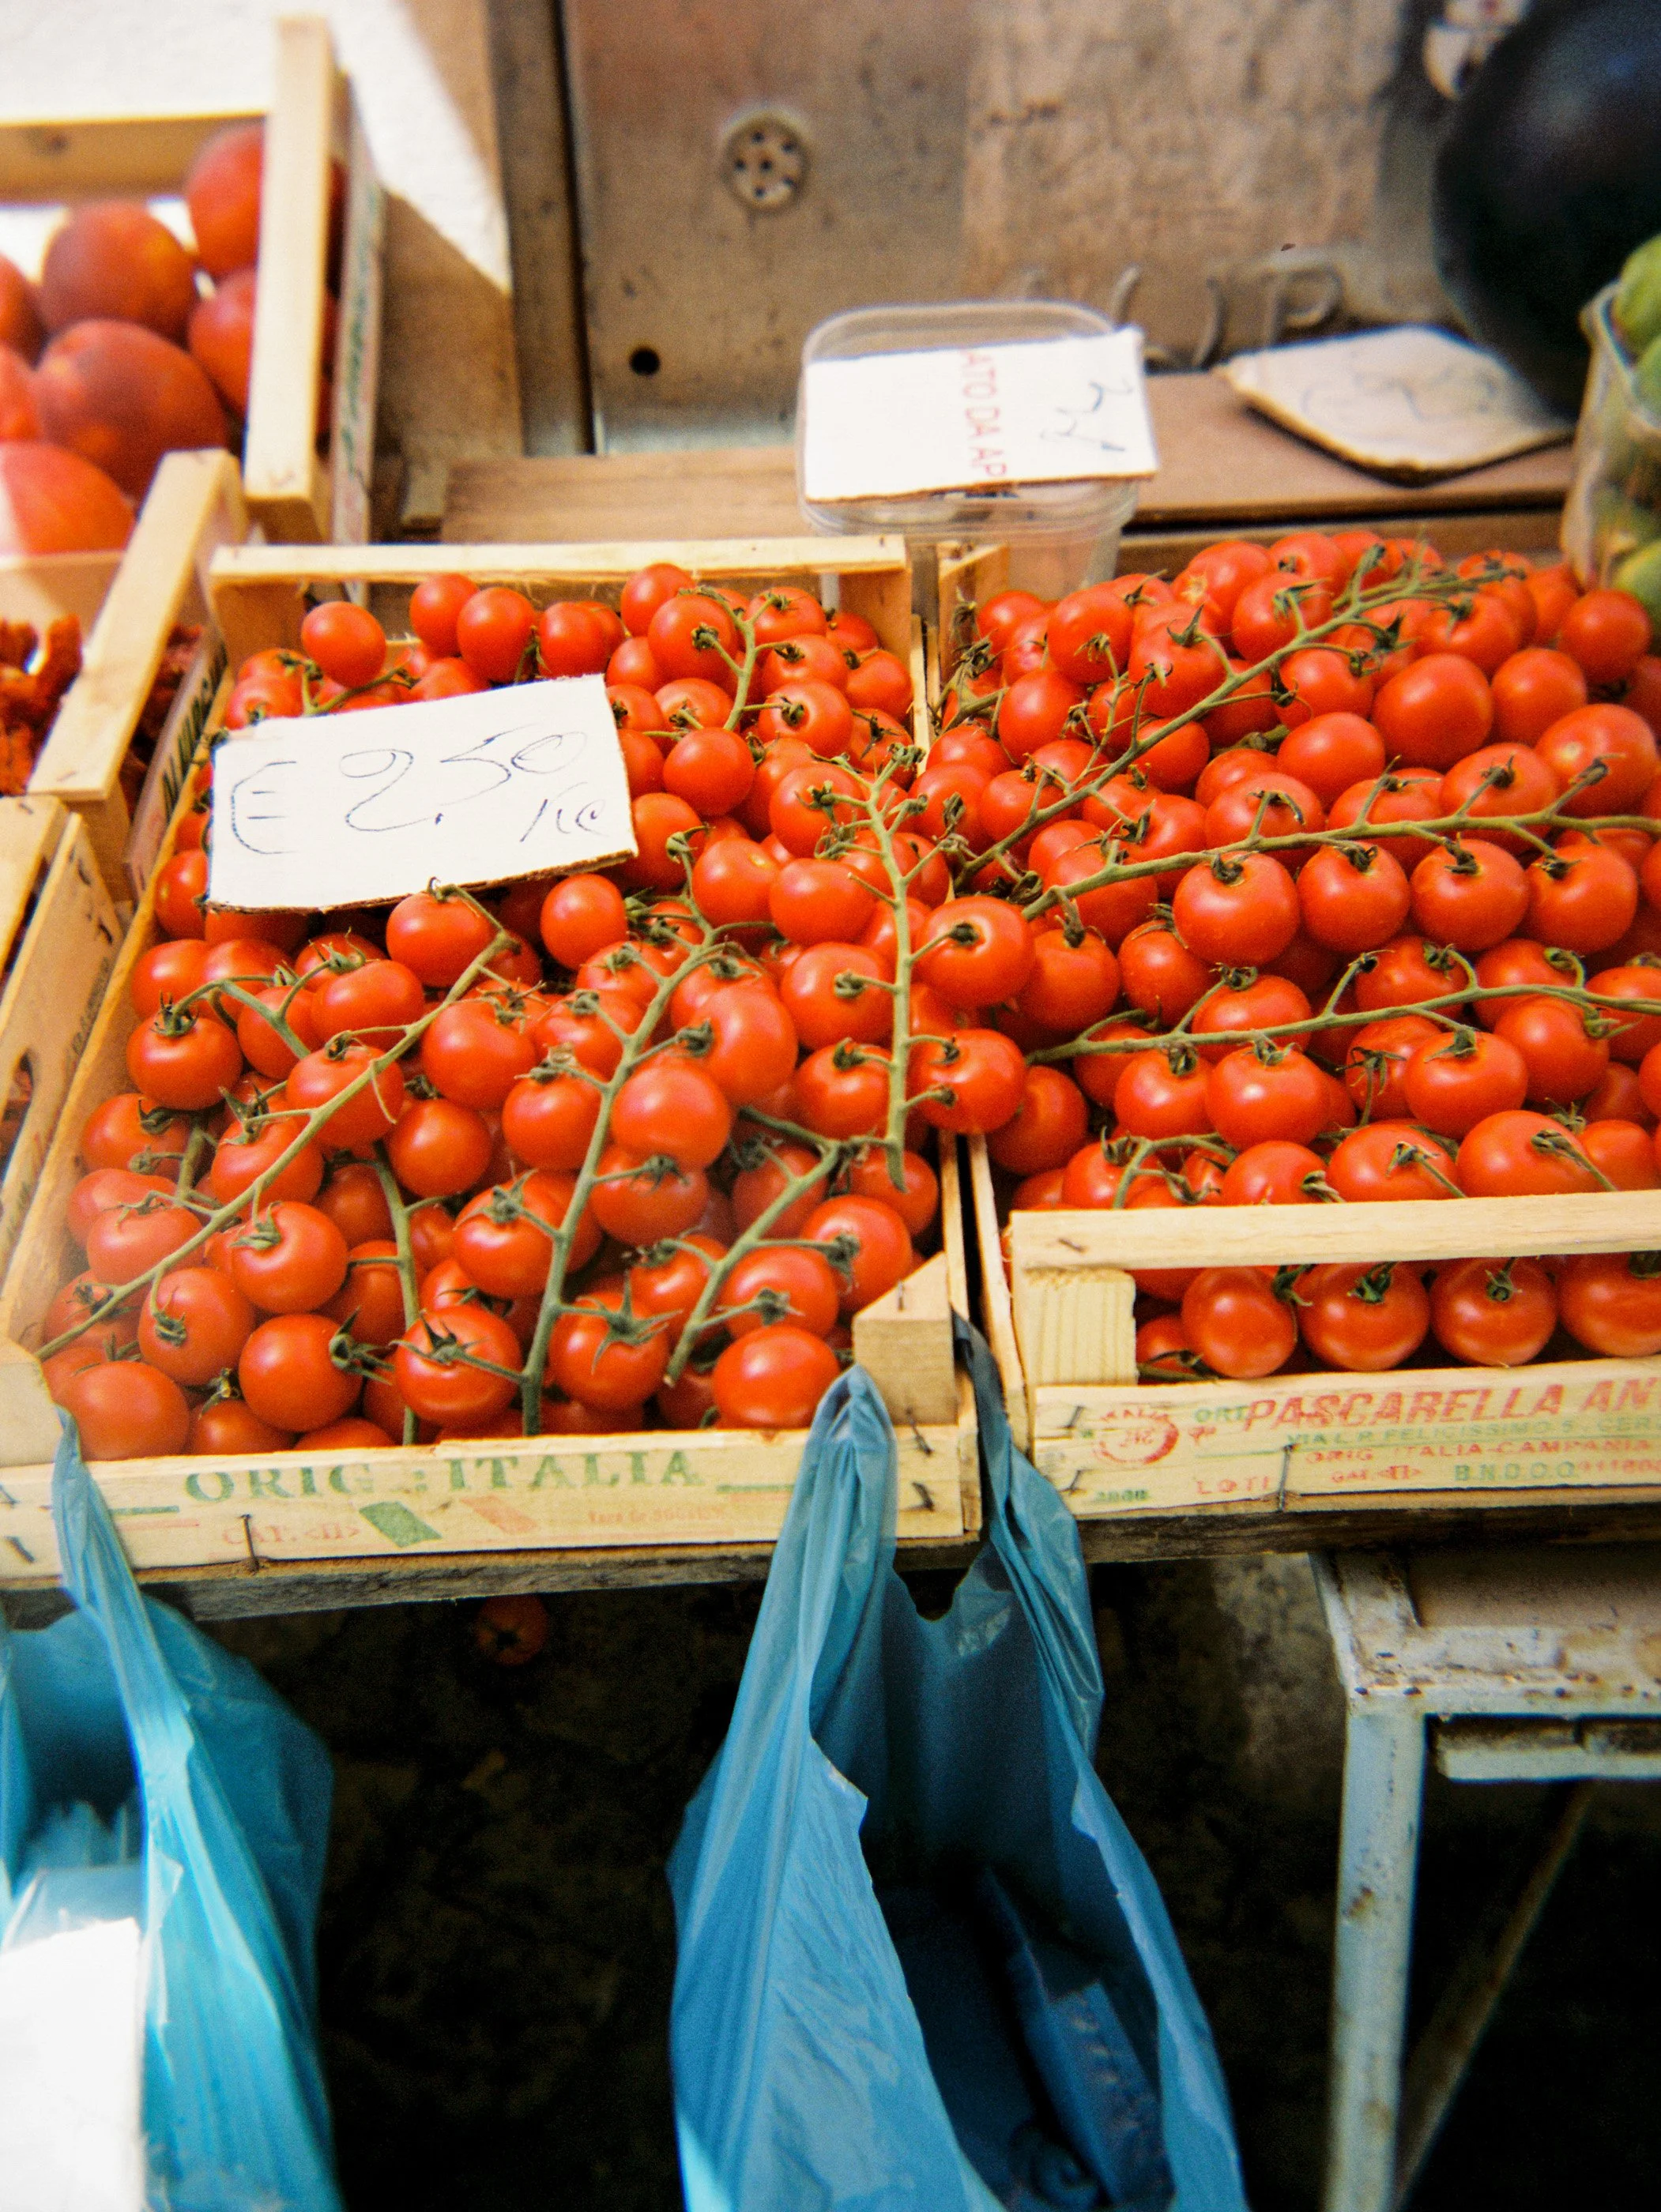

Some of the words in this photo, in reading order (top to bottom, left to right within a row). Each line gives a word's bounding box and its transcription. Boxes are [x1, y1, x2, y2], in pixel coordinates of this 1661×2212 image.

[965, 407, 1001, 437] DA
[231, 760, 299, 855] €
[1244, 1382, 1566, 1432] PASCARELLA
[443, 1449, 707, 1492] ITALIA
